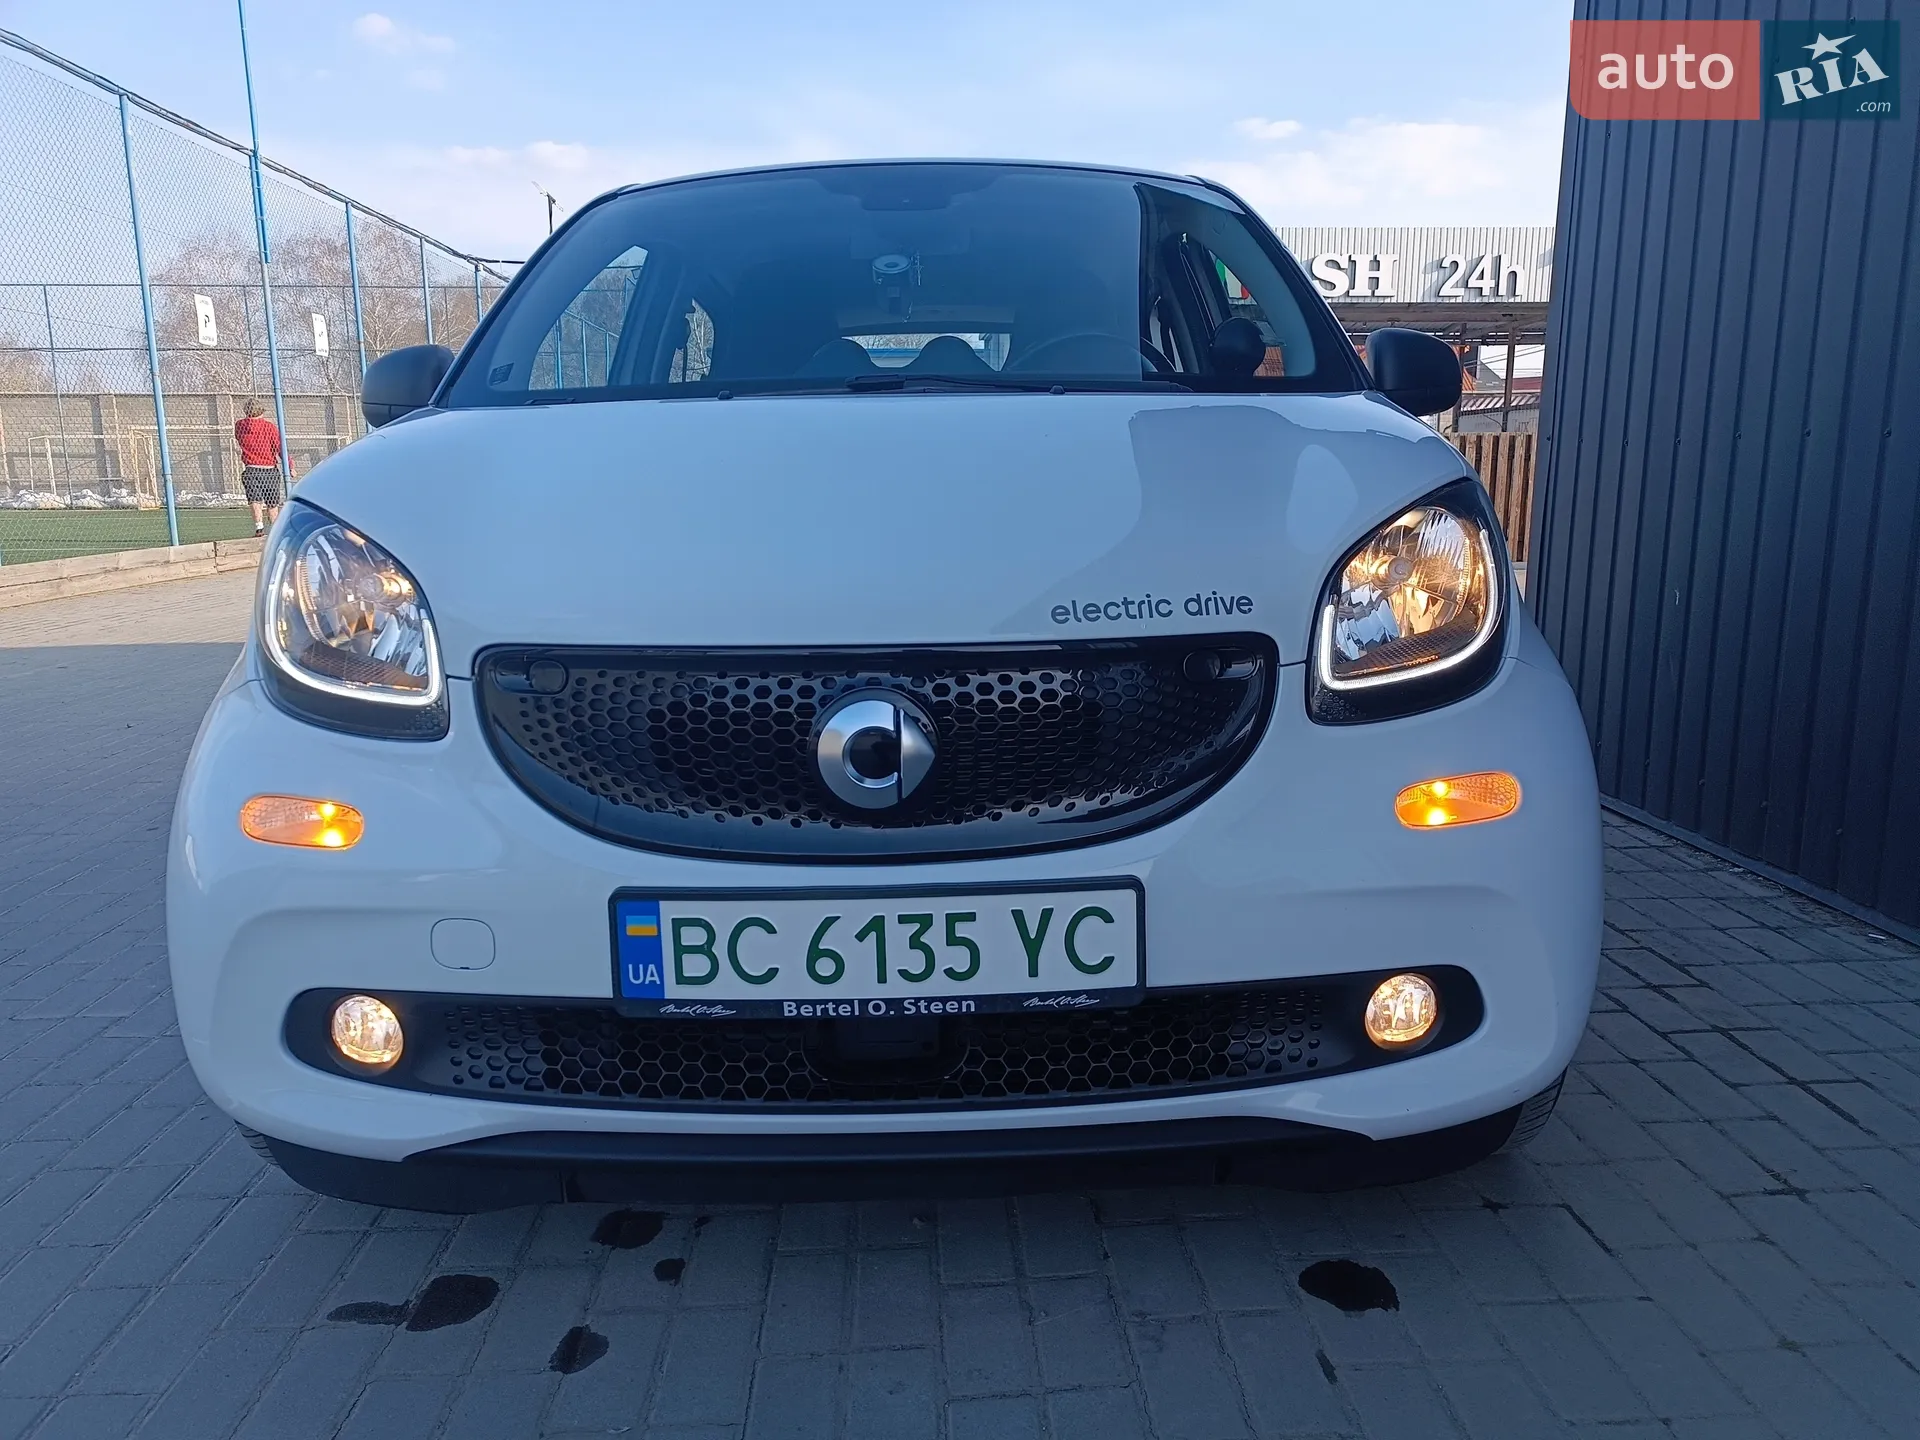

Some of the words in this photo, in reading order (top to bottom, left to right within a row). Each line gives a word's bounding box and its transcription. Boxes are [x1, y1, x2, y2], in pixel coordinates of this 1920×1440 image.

[1437, 254, 1525, 297] 24h
[1050, 593, 1173, 625] electric
[1184, 590, 1254, 616] drive
[671, 916, 780, 986] BC
[805, 911, 981, 986] 6135
[1011, 906, 1115, 978] YC
[628, 964, 661, 985] UA
[783, 999, 859, 1017] Bertel
[867, 1000, 895, 1016] O.
[903, 999, 976, 1015] Steen
